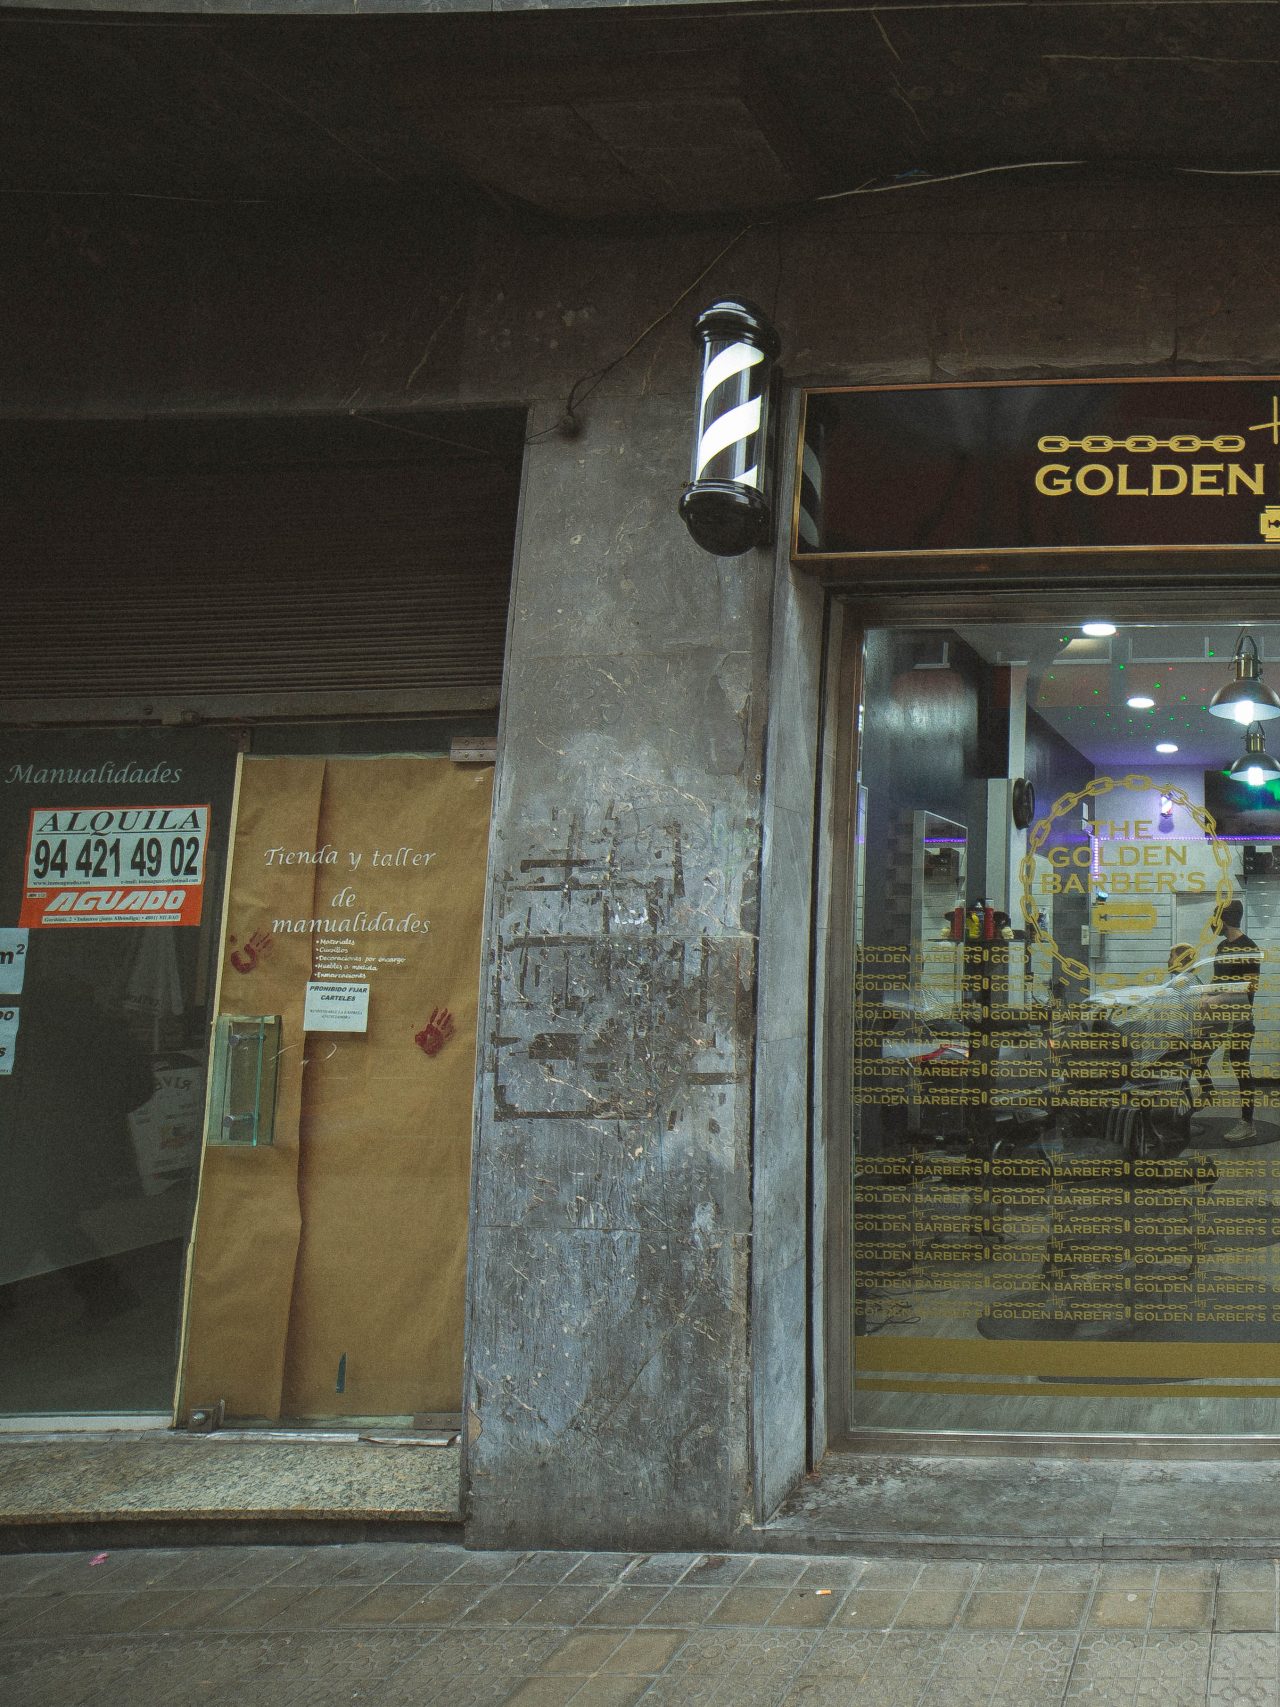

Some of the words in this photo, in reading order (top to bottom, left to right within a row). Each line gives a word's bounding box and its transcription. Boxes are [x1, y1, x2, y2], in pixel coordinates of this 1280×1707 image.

[1035, 463, 1265, 497] GOLDEN
[5, 761, 183, 784] Manualidades
[37, 809, 201, 836] ALQUILA
[1088, 820, 1153, 839] THE
[34, 839, 68, 879] 94
[75, 838, 121, 878] 421
[130, 837, 162, 877] 49
[170, 836, 200, 876] 02
[264, 845, 338, 866] Tienda
[349, 851, 362, 872] y
[372, 848, 436, 867] taller
[1048, 845, 1188, 868] GOLDEN
[1040, 872, 1207, 894] BARBER'S
[44, 890, 187, 911] AGUADO
[331, 887, 356, 908] de
[272, 912, 431, 934] manualidades
[320, 938, 355, 946] Materiales
[856, 954, 911, 963] GOLDEN
[856, 982, 911, 991] GOLDEN
[320, 994, 356, 1002] CARTELES
[856, 1010, 911, 1019] GOLDEN
[991, 1011, 1048, 1020] GOLDEN
[990, 1040, 1047, 1049] GOLDEN
[1052, 1040, 1120, 1050] BARBER'S
[1130, 1040, 1188, 1050] GOLDEN
[854, 1067, 909, 1076] GOLDEN
[914, 1067, 980, 1077] BARBER'S
[990, 1068, 1047, 1077] GOLDEN
[1051, 1069, 1120, 1078] BARBER'S
[1130, 1069, 1188, 1078] GOLDEN
[1193, 1069, 1261, 1078] BARBER'S
[854, 1095, 909, 1104] GOLDEN
[913, 1095, 980, 1105] BARBER'S
[990, 1097, 1047, 1106] GOLDEN
[1051, 1097, 1120, 1107] BARBER'S
[1130, 1098, 1188, 1107] GOLDEN
[1193, 1098, 1261, 1108] BARBER'S
[855, 1165, 911, 1174] GOLDEN
[915, 1165, 982, 1175] BARBER'S
[992, 1167, 1051, 1176] GOLDEN
[1054, 1167, 1122, 1176] BARBER'S
[1134, 1168, 1192, 1177] GOLDEN
[1197, 1168, 1266, 1178] BARBER'S
[855, 1194, 911, 1203] GOLDEN
[915, 1194, 982, 1203] BARBER'S
[992, 1195, 1050, 1204] GOLDEN
[1054, 1196, 1122, 1205] BARBER'S
[1134, 1197, 1192, 1206] GOLDEN
[1197, 1197, 1266, 1206] BARBER'S
[855, 1222, 911, 1231] GOLDEN
[915, 1222, 982, 1232] BARBER'S
[992, 1224, 1050, 1233] GOLDEN
[1054, 1224, 1122, 1234] BARBER'S
[1134, 1225, 1192, 1235] GOLDEN
[1197, 1226, 1266, 1235] BARBER'S
[855, 1250, 911, 1259] GOLDEN
[915, 1251, 982, 1261] BARBER'S
[992, 1252, 1050, 1262] GOLDEN
[1054, 1253, 1122, 1263] BARBER'S
[1135, 1254, 1192, 1264] GOLDEN
[1197, 1254, 1266, 1264] BARBER'S
[855, 1279, 911, 1288] GOLDEN
[915, 1280, 982, 1289] BARBER'S
[992, 1281, 1051, 1291] GOLDEN
[1054, 1282, 1123, 1291] BARBER'S
[1134, 1283, 1192, 1293] GOLDEN
[1197, 1283, 1266, 1293] BARBER'S
[993, 1310, 1051, 1319] GOLDEN
[1055, 1310, 1124, 1320] BARBER'S
[1134, 1312, 1192, 1322] GOLDEN
[1197, 1312, 1266, 1322] BARBER'S
